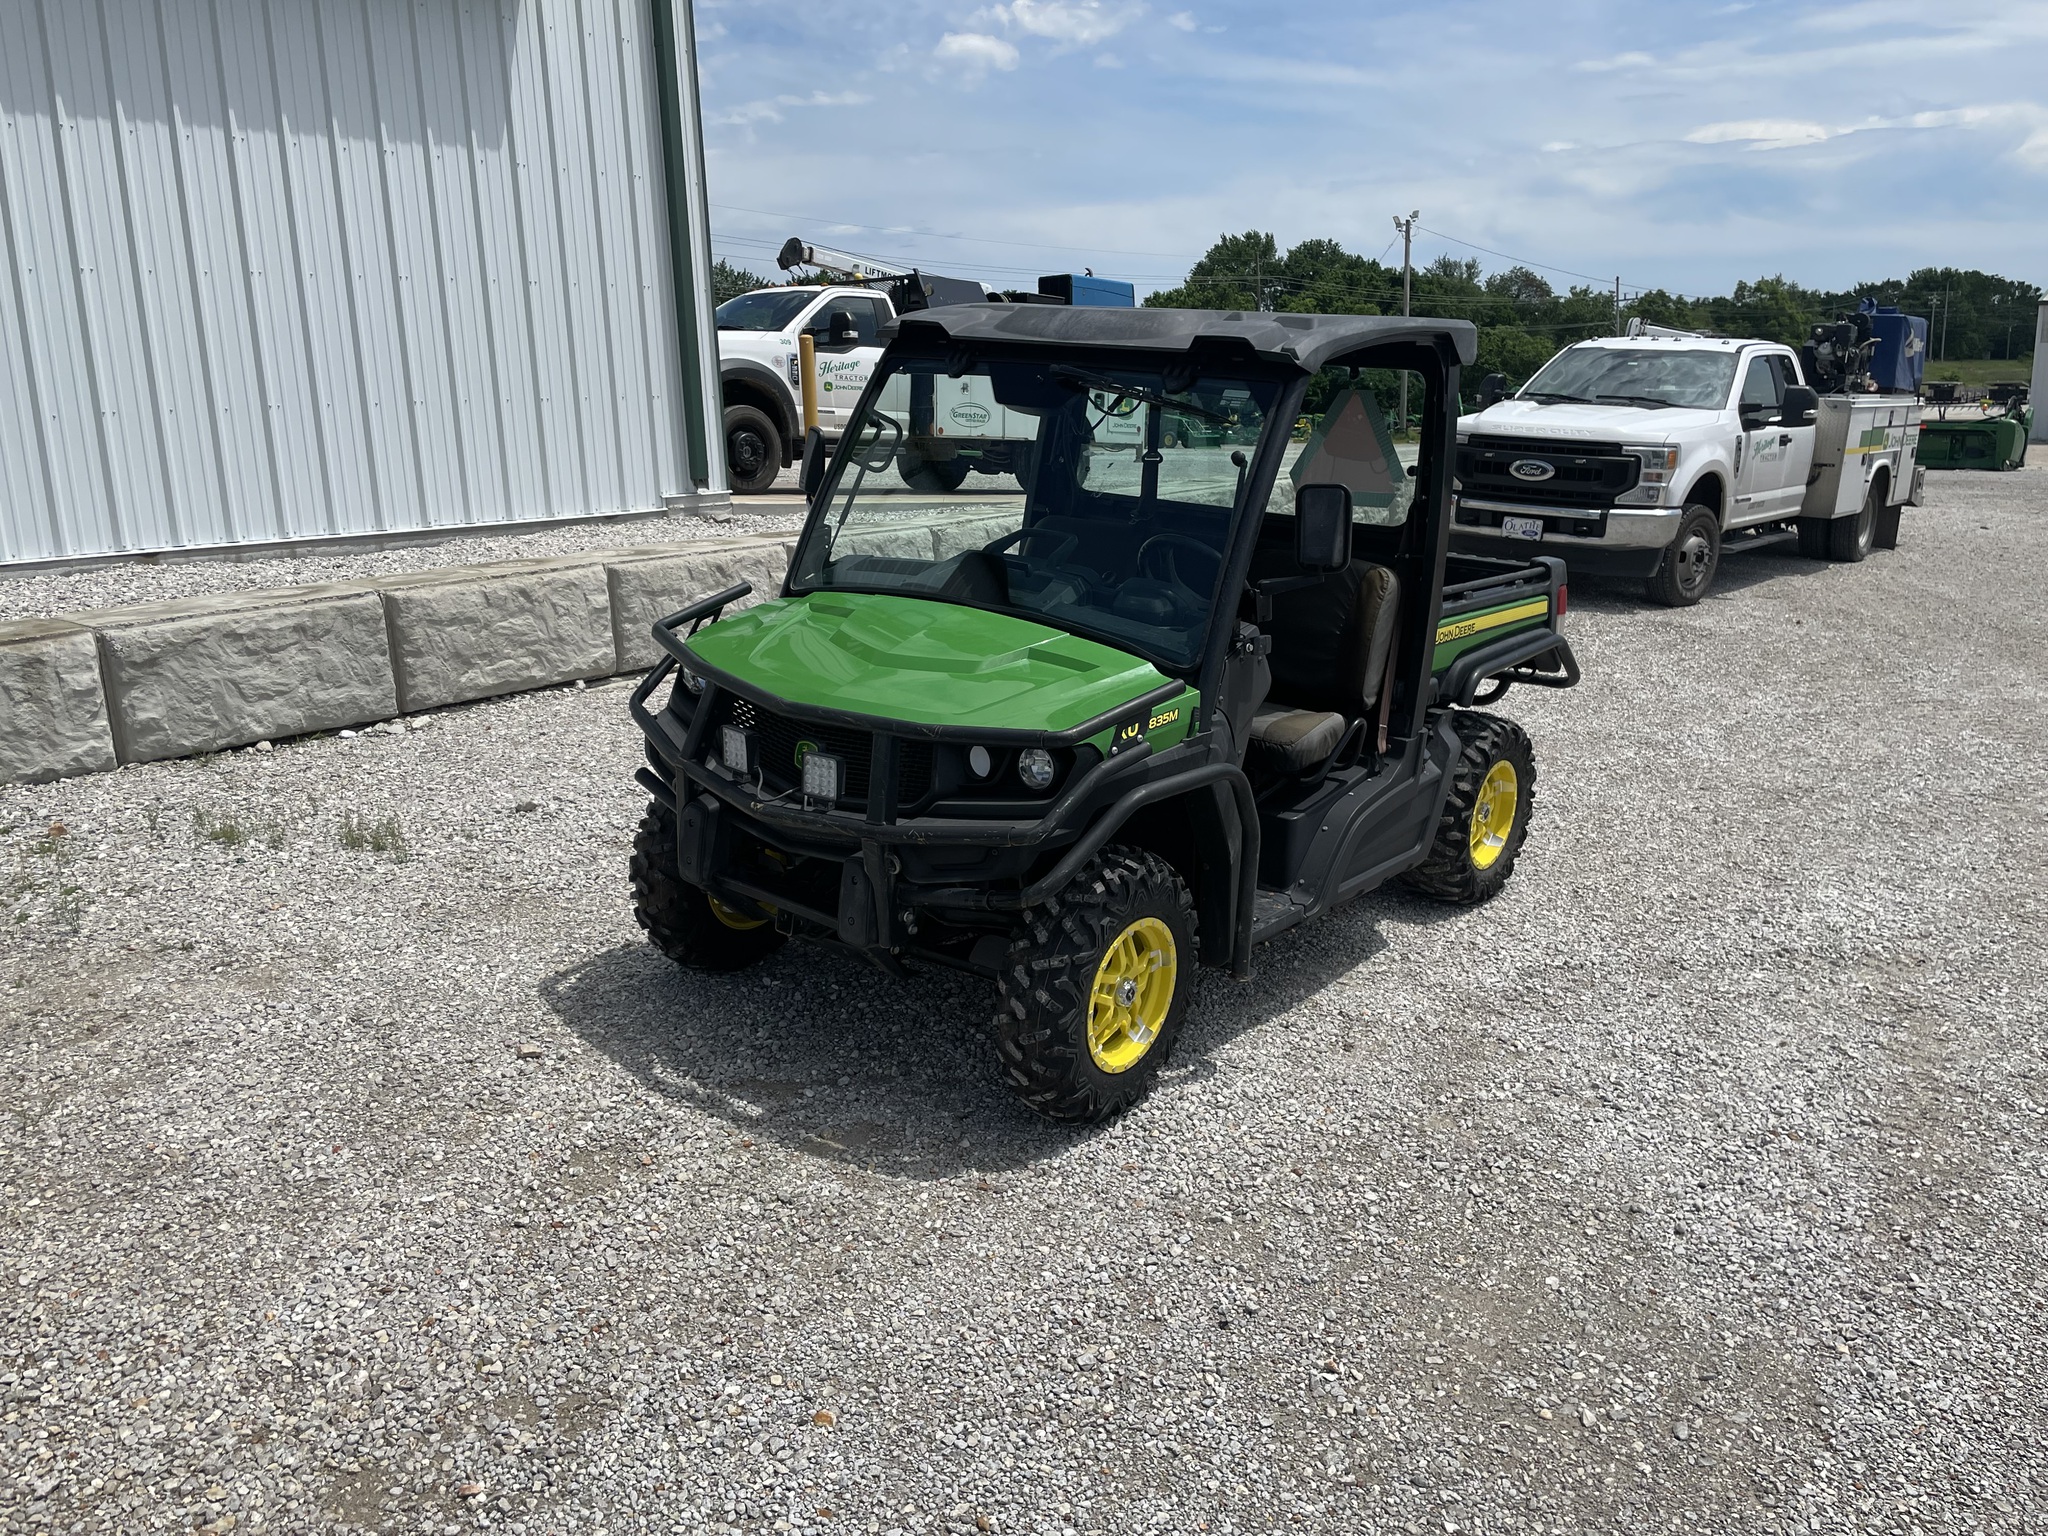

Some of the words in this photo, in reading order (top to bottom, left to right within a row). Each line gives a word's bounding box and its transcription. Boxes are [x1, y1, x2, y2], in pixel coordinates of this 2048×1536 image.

[819, 360, 860, 377] Heritage
[1491, 424, 1545, 434] SUPER
[1520, 465, 1542, 475] Ford
[1435, 629, 1453, 644] JOHN
[1454, 623, 1475, 638] DEERE
[1148, 708, 1179, 730] 835M
